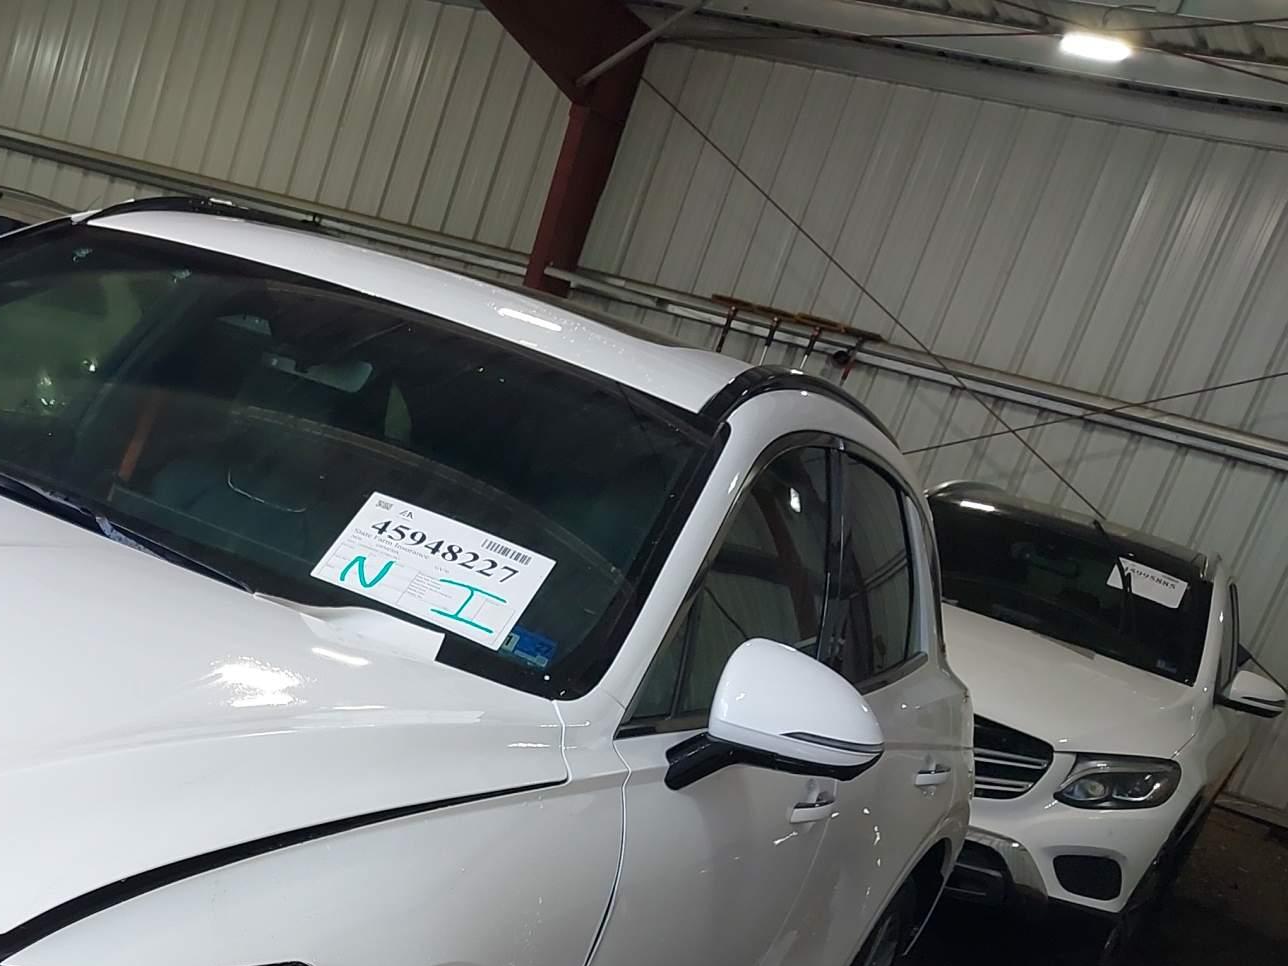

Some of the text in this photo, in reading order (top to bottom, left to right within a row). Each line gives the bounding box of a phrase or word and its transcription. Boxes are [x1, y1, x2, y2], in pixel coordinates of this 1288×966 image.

[339, 555, 396, 588] N
[371, 520, 519, 583] 45948227
[430, 578, 507, 634] I
